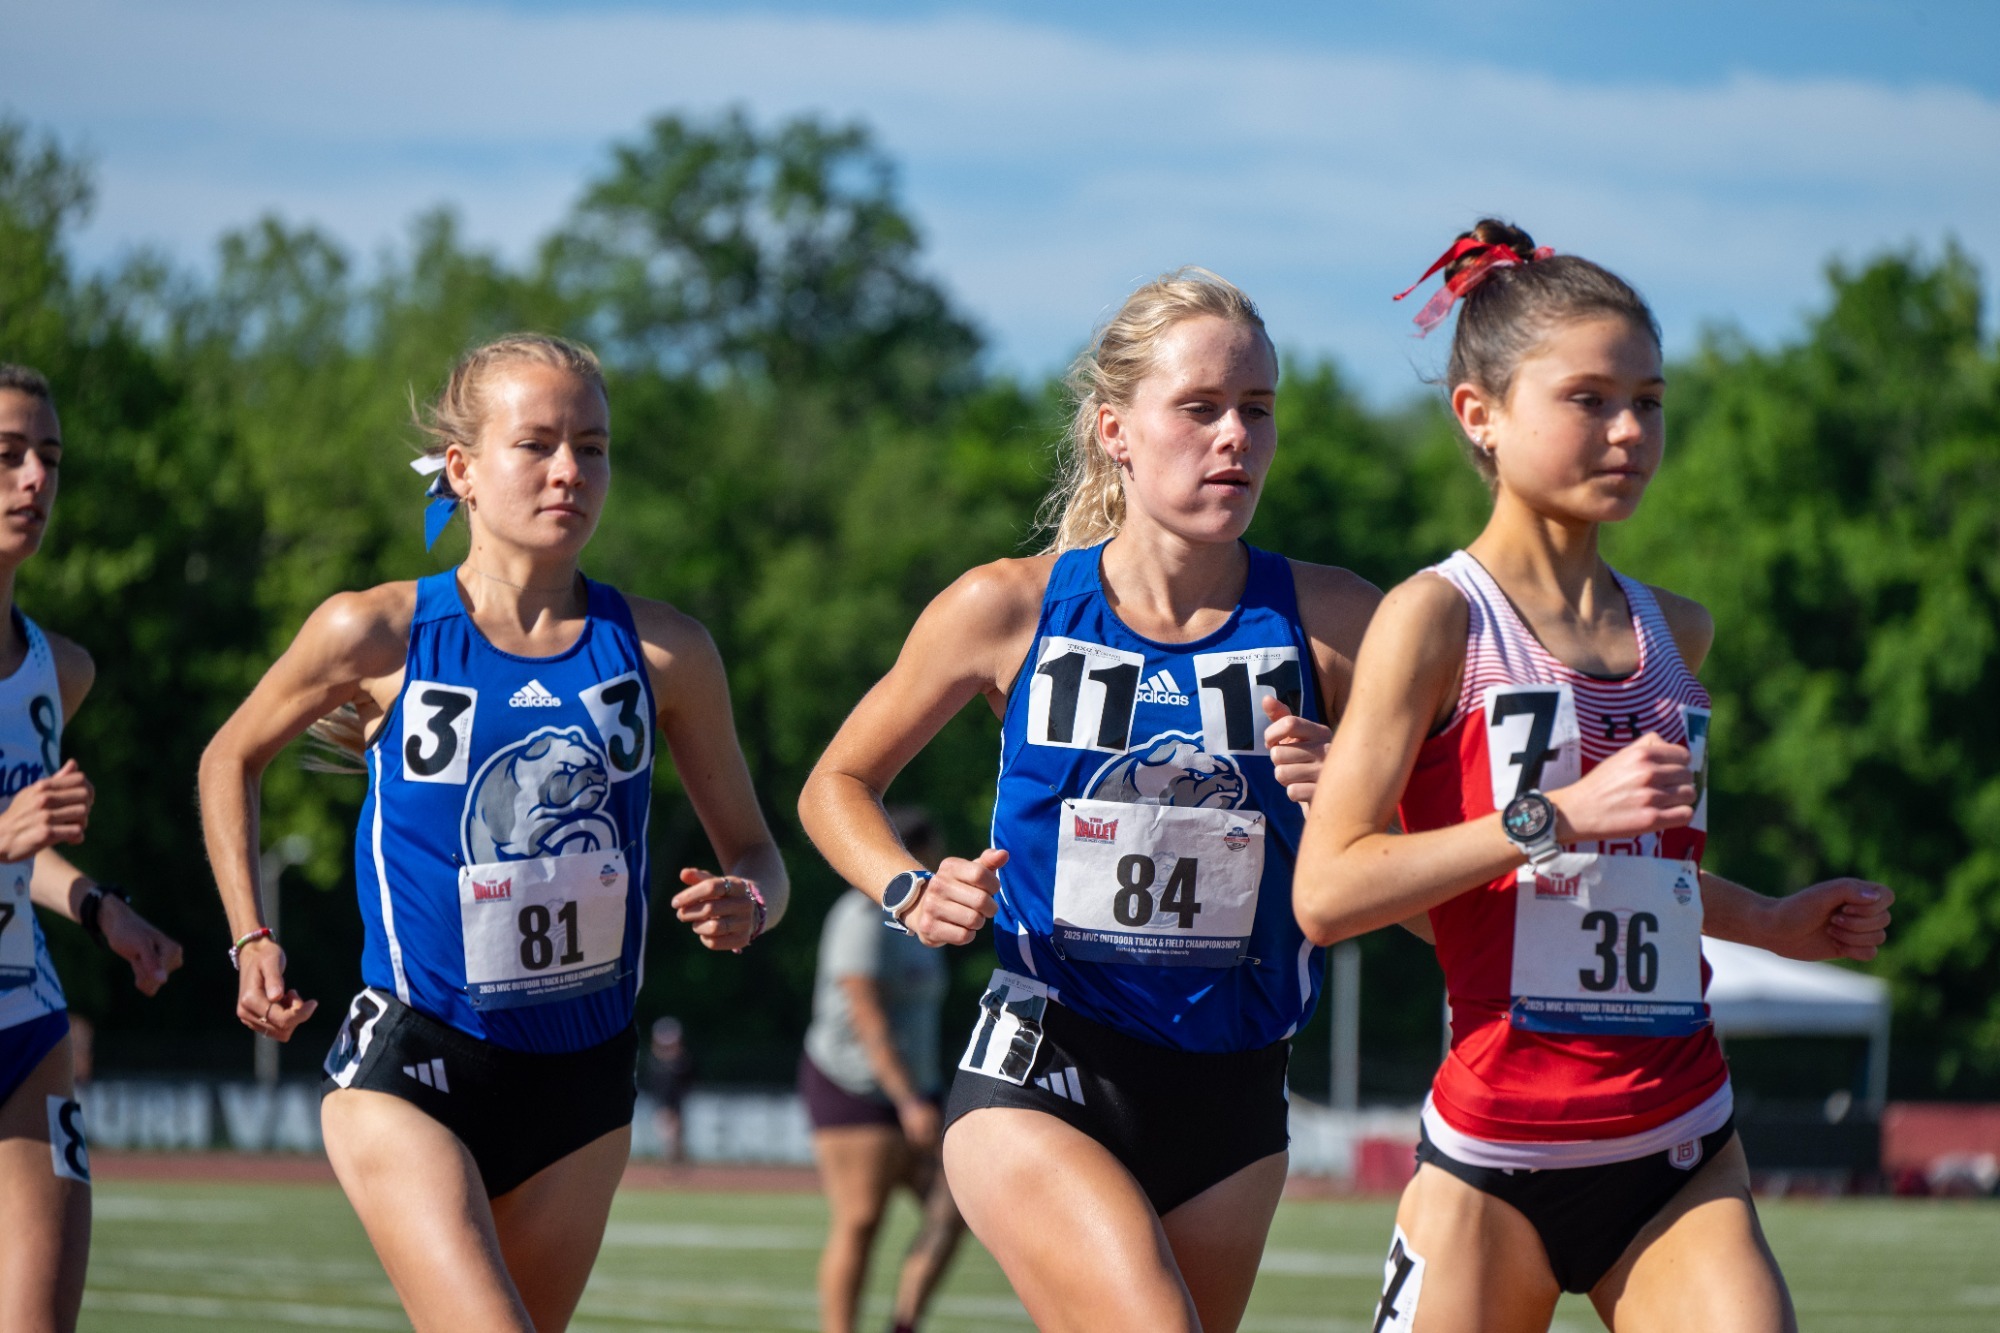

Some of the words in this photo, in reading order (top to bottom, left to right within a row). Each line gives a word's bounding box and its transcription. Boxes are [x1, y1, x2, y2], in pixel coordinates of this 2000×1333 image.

[509, 695, 562, 708] adidas
[1037, 651, 1141, 750] 11
[1136, 689, 1190, 707] adidas
[405, 689, 472, 776] 3
[601, 679, 645, 772] 3
[1491, 691, 1560, 801] 7
[1074, 814, 1119, 840] VALLEY
[472, 877, 511, 900] VALLEY
[1113, 854, 1202, 928] 84
[1535, 872, 1582, 896] VALLEY
[518, 901, 584, 971] 81
[1063, 930, 1081, 941] 2025
[1082, 932, 1098, 943] MVC
[1099, 934, 1133, 946] OUTDOOR
[1134, 937, 1158, 948] TRACK
[1158, 938, 1164, 947] &
[1165, 938, 1184, 949] FIELD
[1185, 939, 1241, 950] CHAMPIONSHIPS
[1579, 911, 1659, 993] 36
[479, 984, 495, 994] 2025
[496, 982, 511, 992] MVC
[512, 979, 540, 991] OUTDOOR
[541, 977, 559, 987] TRACK
[565, 973, 578, 983] FIELD
[1545, 1002, 1563, 1012] MVC
[1565, 1002, 1600, 1013] OUTDOOR
[1601, 1004, 1624, 1014] TRACK
